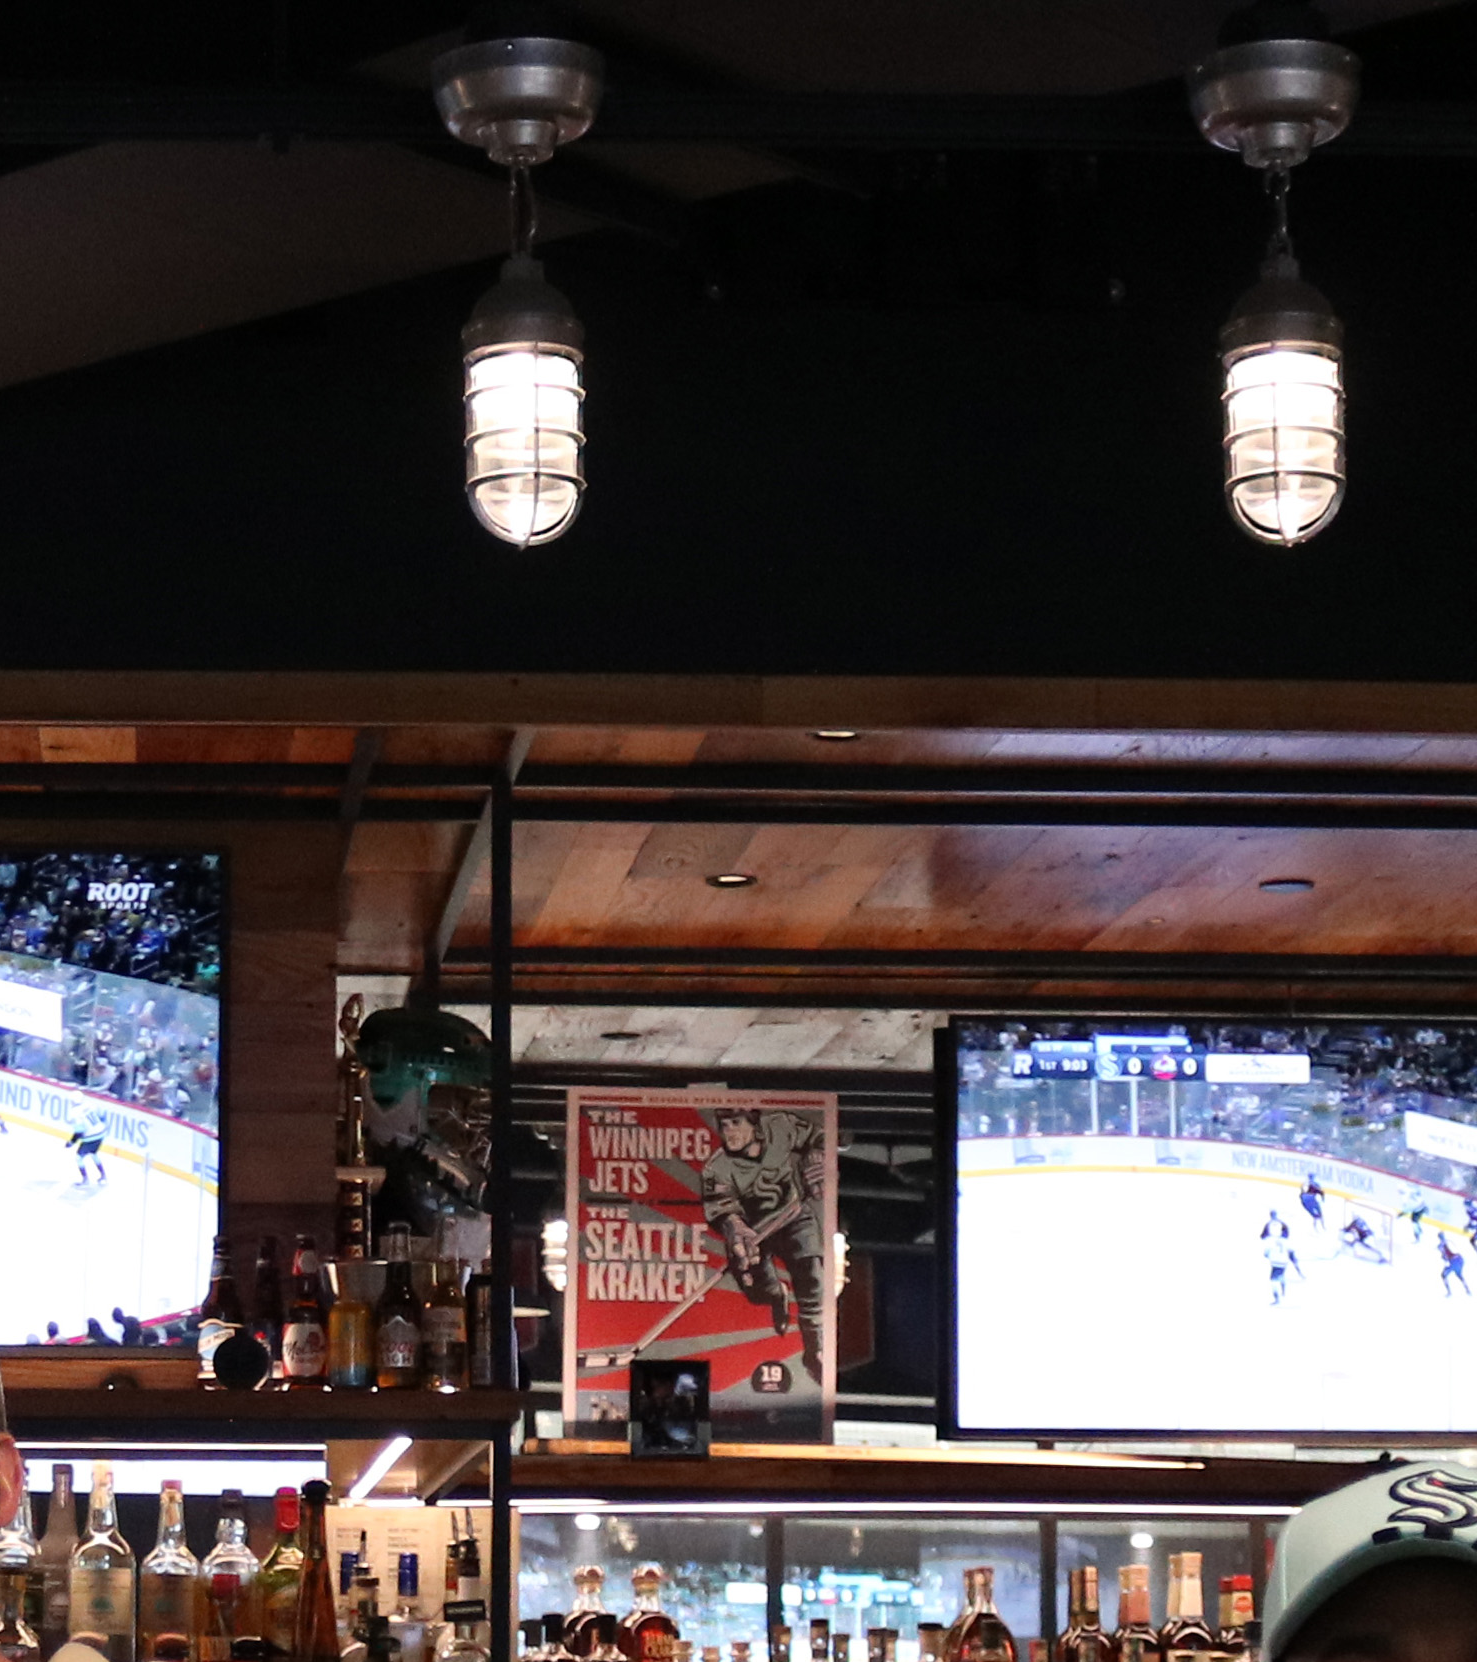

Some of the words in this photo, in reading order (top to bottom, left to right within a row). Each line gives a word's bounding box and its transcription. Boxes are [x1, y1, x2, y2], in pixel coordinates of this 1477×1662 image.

[87, 882, 156, 902] ROOT
[36, 1084, 80, 1123] YOU
[587, 1110, 638, 1125] THE
[588, 1126, 712, 1161] WINNIPEG
[588, 1161, 649, 1195] JETS
[1231, 1150, 1257, 1169] NEW
[1259, 1153, 1334, 1186] AMSTERDAM
[1334, 1168, 1375, 1194] VODKA
[585, 1206, 629, 1220] THE
[585, 1221, 708, 1262] SEATTLE
[586, 1262, 705, 1303] KRAKEN
[761, 1365, 783, 1382] 19
